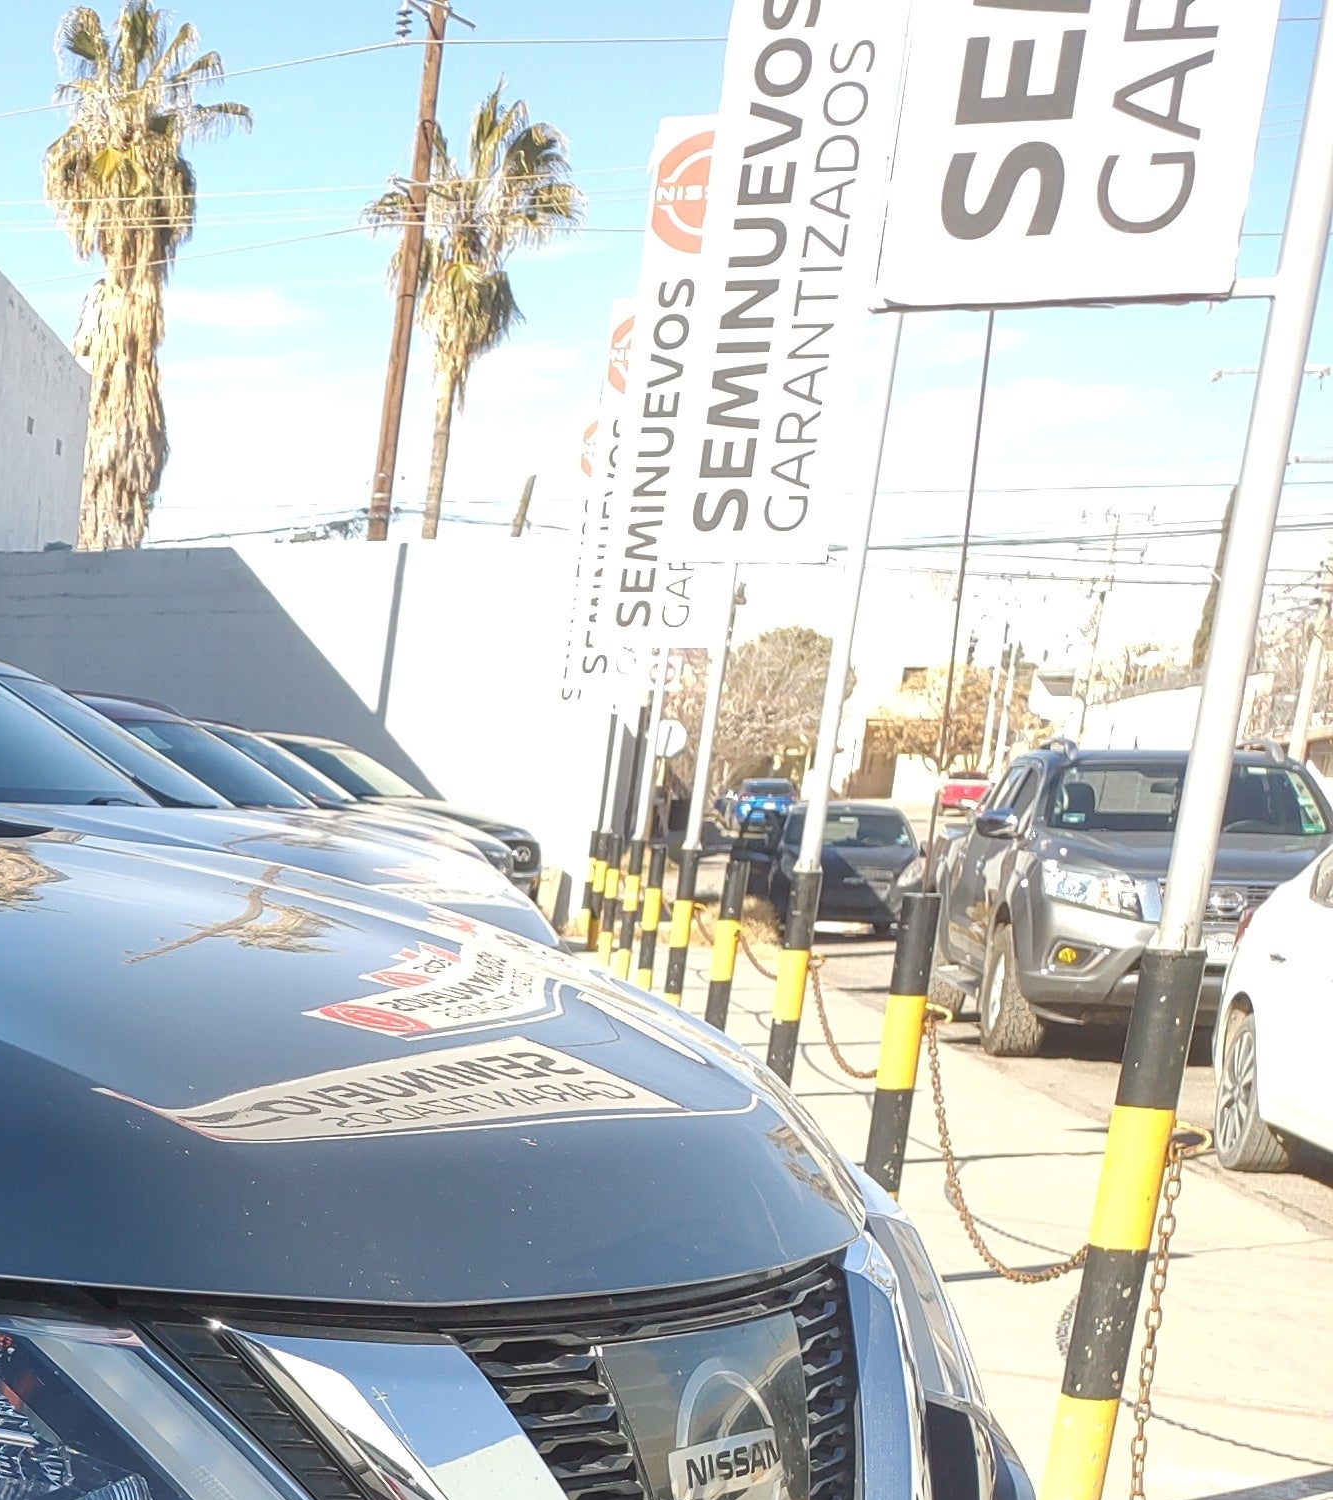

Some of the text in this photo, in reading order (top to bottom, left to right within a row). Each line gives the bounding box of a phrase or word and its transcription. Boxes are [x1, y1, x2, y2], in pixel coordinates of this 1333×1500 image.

[656, 184, 708, 202] NIS
[693, 0, 821, 532] SEMINUEVOS
[941, 0, 1090, 240] SE
[764, 39, 875, 531] GARANTIZADOS
[616, 278, 695, 627] SEMINUEVOS
[685, 1437, 782, 1489] NISSAN
